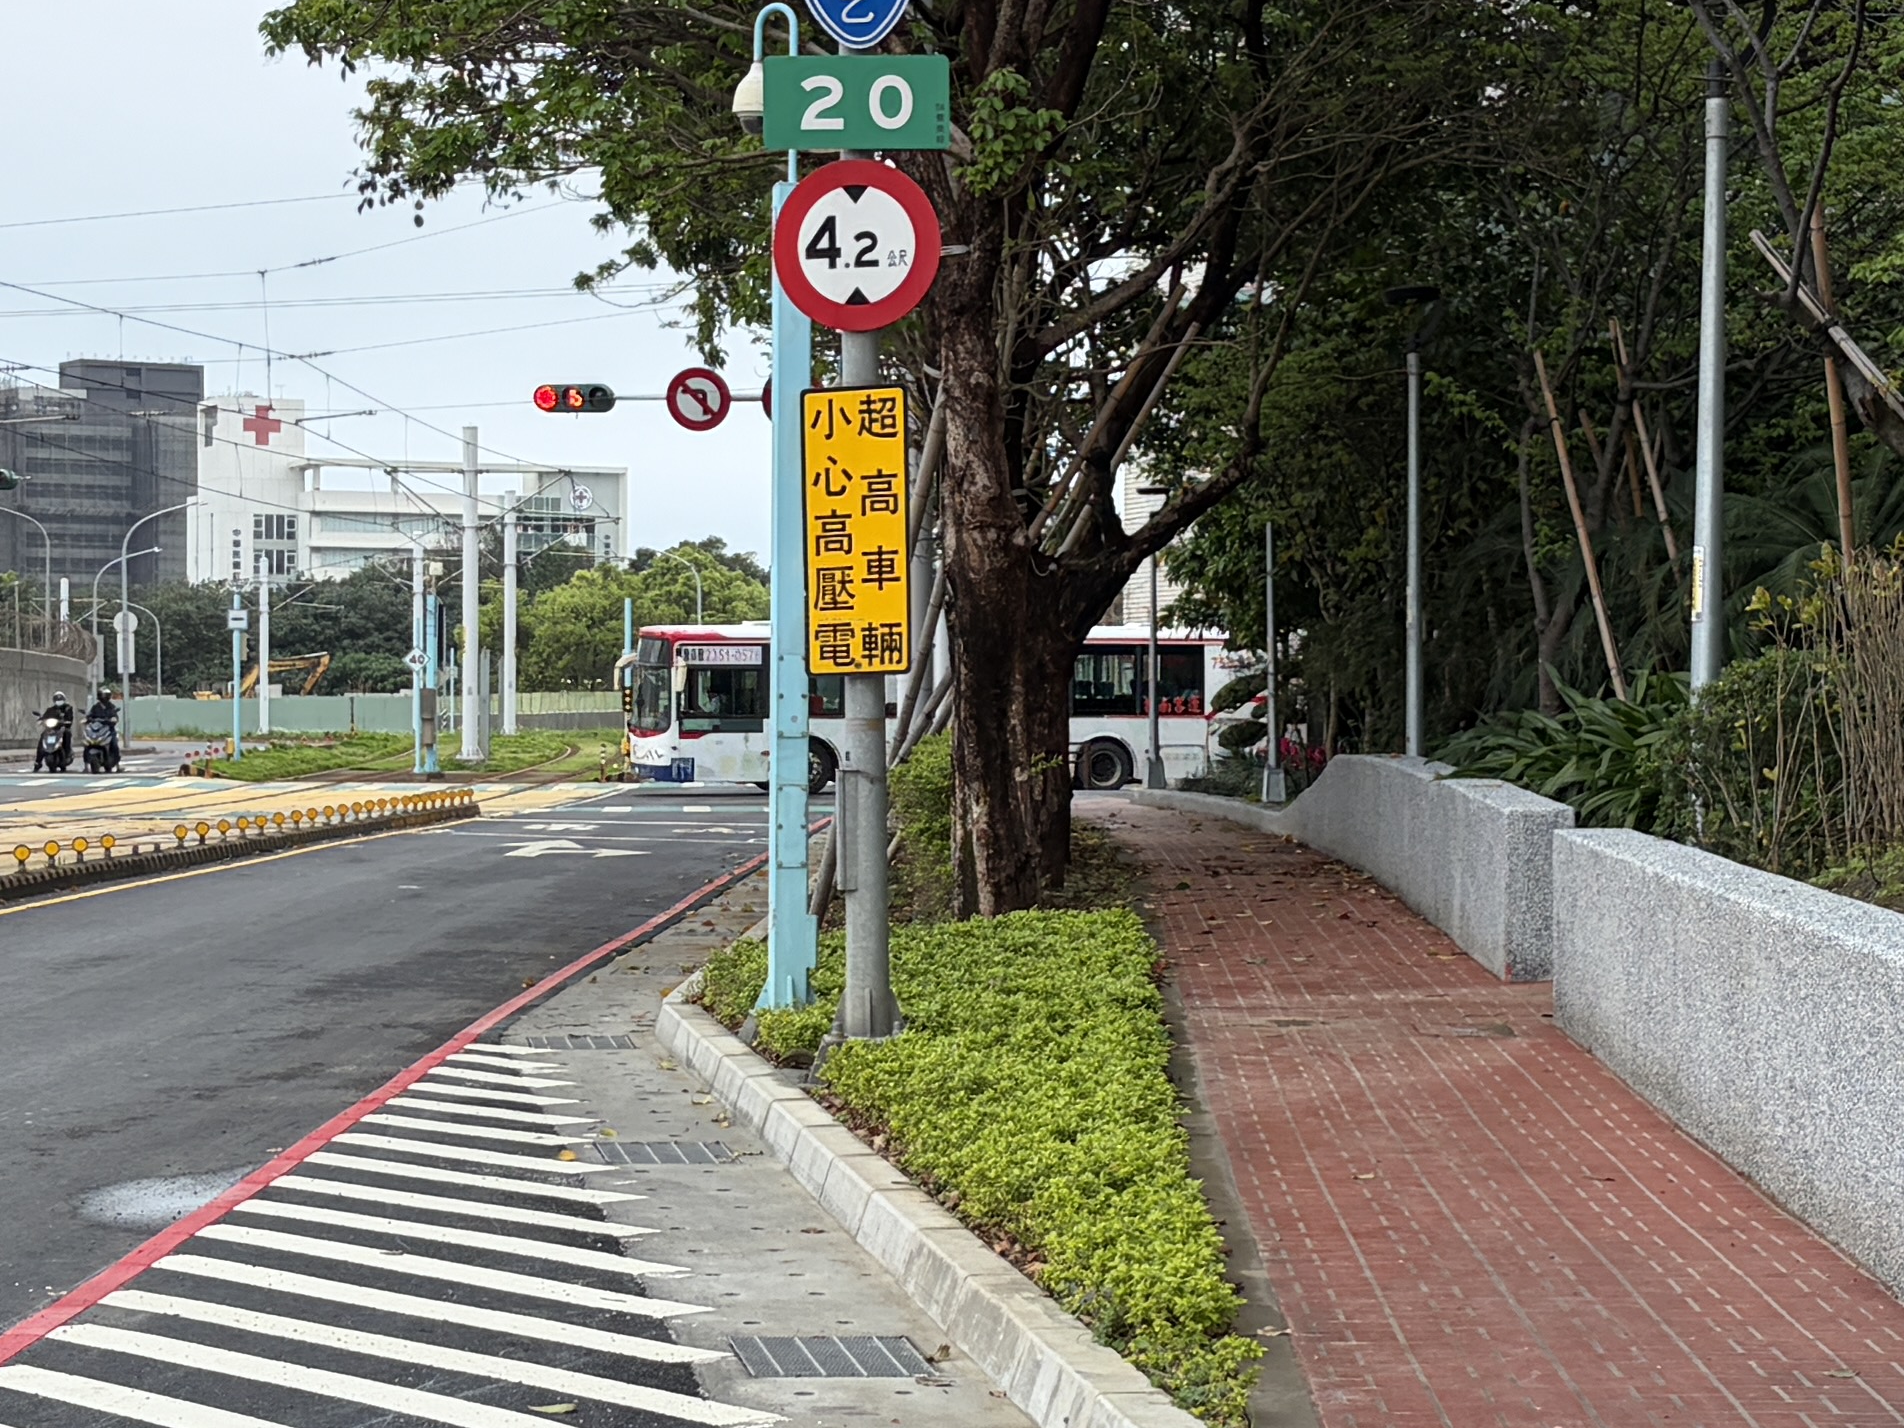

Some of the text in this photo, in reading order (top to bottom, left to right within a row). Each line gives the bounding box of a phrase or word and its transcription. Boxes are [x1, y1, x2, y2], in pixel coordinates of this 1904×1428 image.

[800, 74, 914, 131] 20
[805, 215, 908, 270] 4.2 公尺
[810, 398, 856, 668] 小心高壓電
[857, 394, 904, 668] 超高車輛
